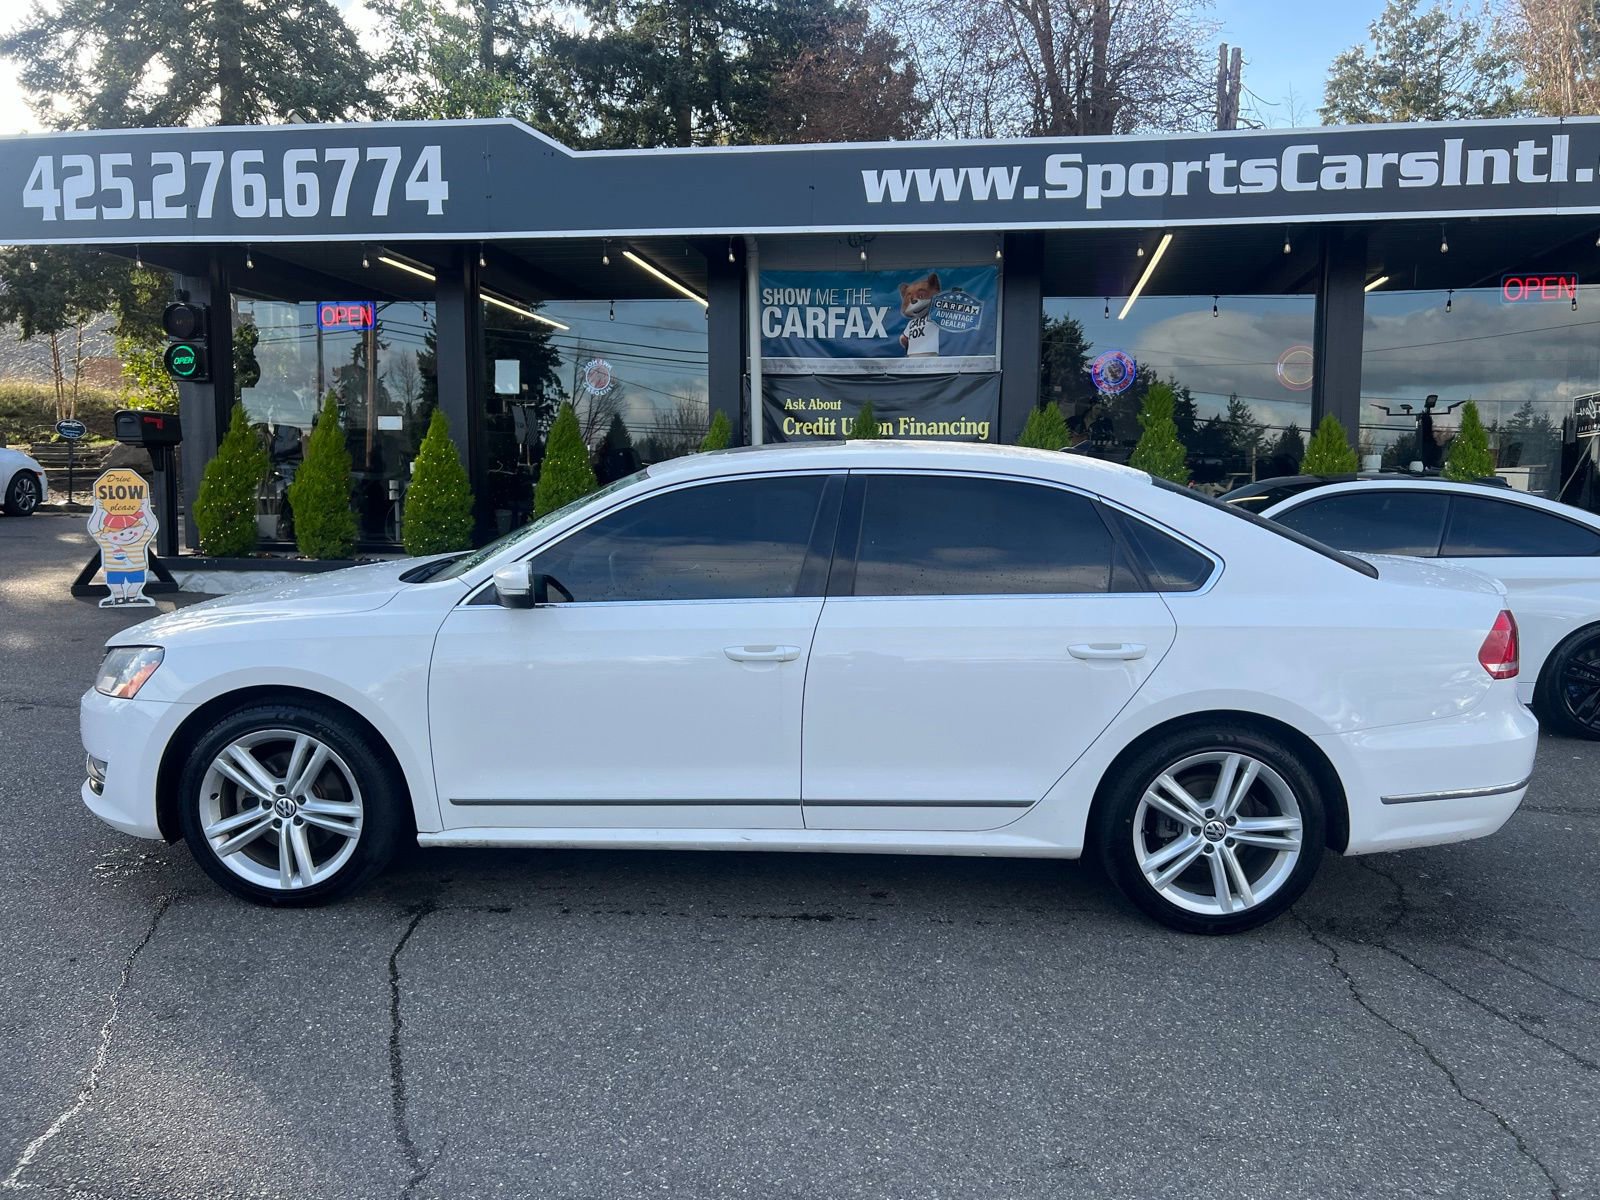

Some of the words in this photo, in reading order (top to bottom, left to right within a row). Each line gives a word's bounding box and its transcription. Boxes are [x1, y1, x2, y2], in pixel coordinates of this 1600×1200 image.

[861, 135, 1600, 209] www.SportsCarsIntl.
[23, 146, 449, 221] 425.276.6774
[1503, 276, 1575, 301] OPEN
[762, 288, 811, 305] SHOW
[816, 288, 838, 305] ME
[843, 288, 872, 305] THE
[935, 301, 979, 314] CARFAX
[321, 306, 372, 326] OPEN
[762, 306, 888, 338] CARFAX
[910, 316, 926, 329] CAR
[935, 311, 973, 322] ADVANTAGE
[940, 319, 966, 329] DEALER
[909, 327, 925, 339] FOX
[784, 399, 806, 410] Ask
[808, 399, 841, 410] About
[783, 417, 836, 435] Credit
[899, 417, 990, 440] Financing
[106, 474, 131, 482] Drive
[98, 485, 143, 499] SLOW
